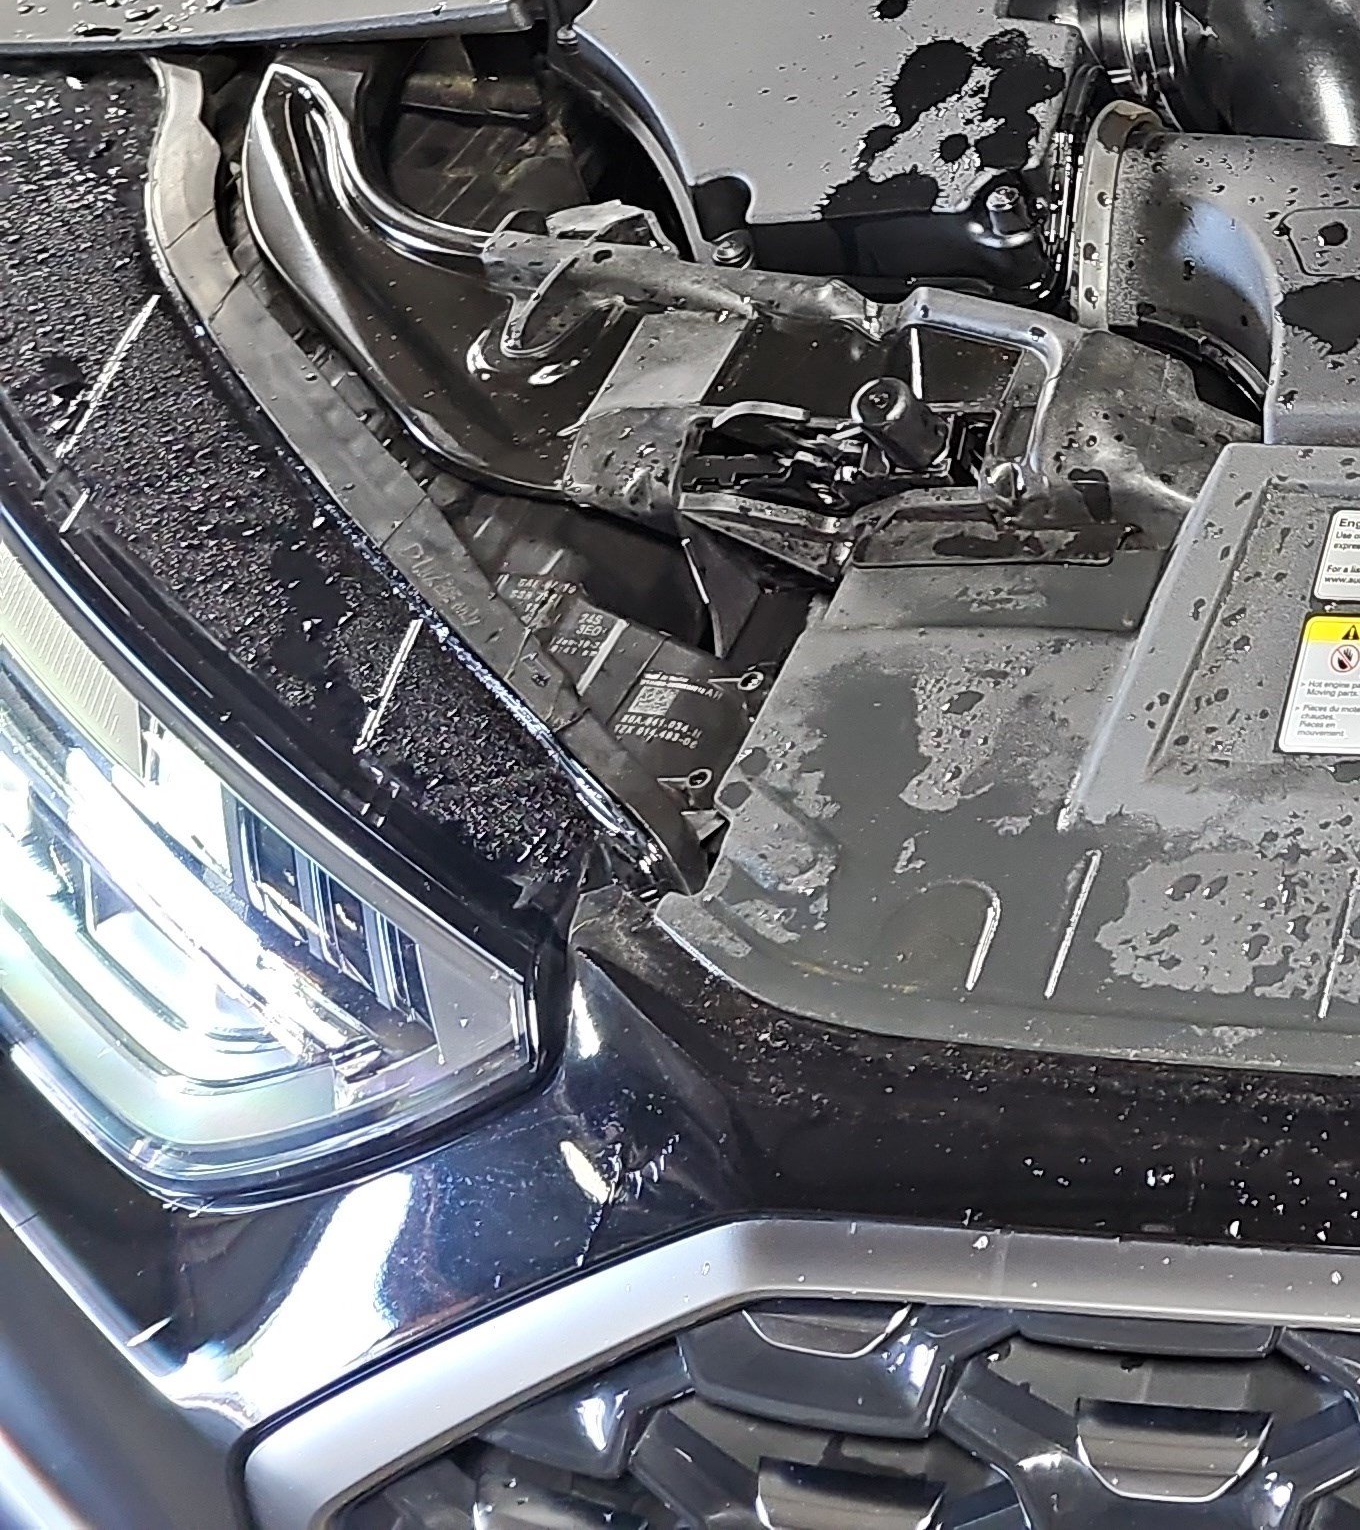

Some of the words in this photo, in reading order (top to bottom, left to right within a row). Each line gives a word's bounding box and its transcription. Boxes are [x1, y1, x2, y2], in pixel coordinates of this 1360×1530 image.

[1327, 565, 1341, 573] For
[1324, 682, 1350, 690] engine
[1307, 689, 1335, 697] Moving
[1338, 690, 1358, 698] parts.
[1329, 705, 1339, 713] du
